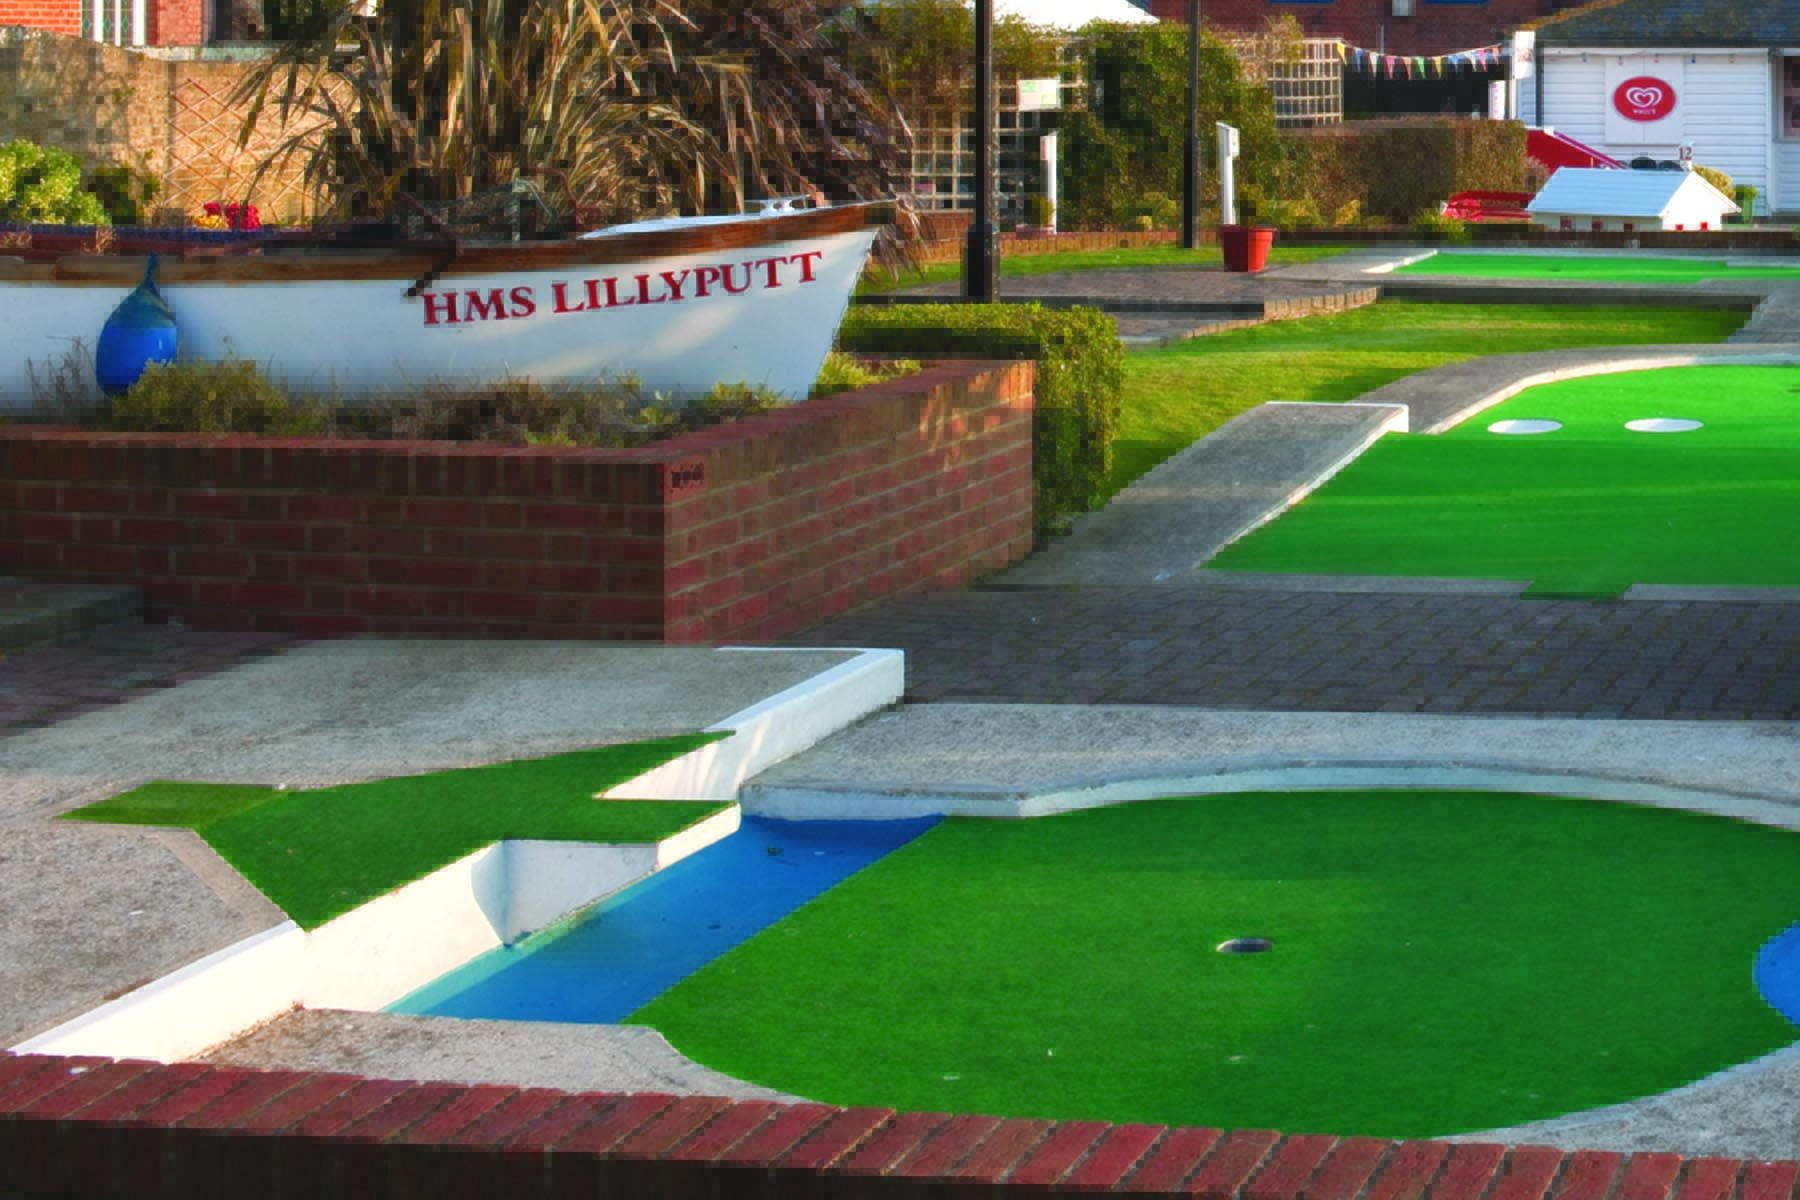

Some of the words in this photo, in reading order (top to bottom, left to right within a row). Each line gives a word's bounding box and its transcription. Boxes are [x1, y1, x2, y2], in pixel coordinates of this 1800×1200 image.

[1679, 146, 1692, 160] 12
[422, 286, 537, 325] HMS
[551, 251, 823, 313] LILLYPUTT
